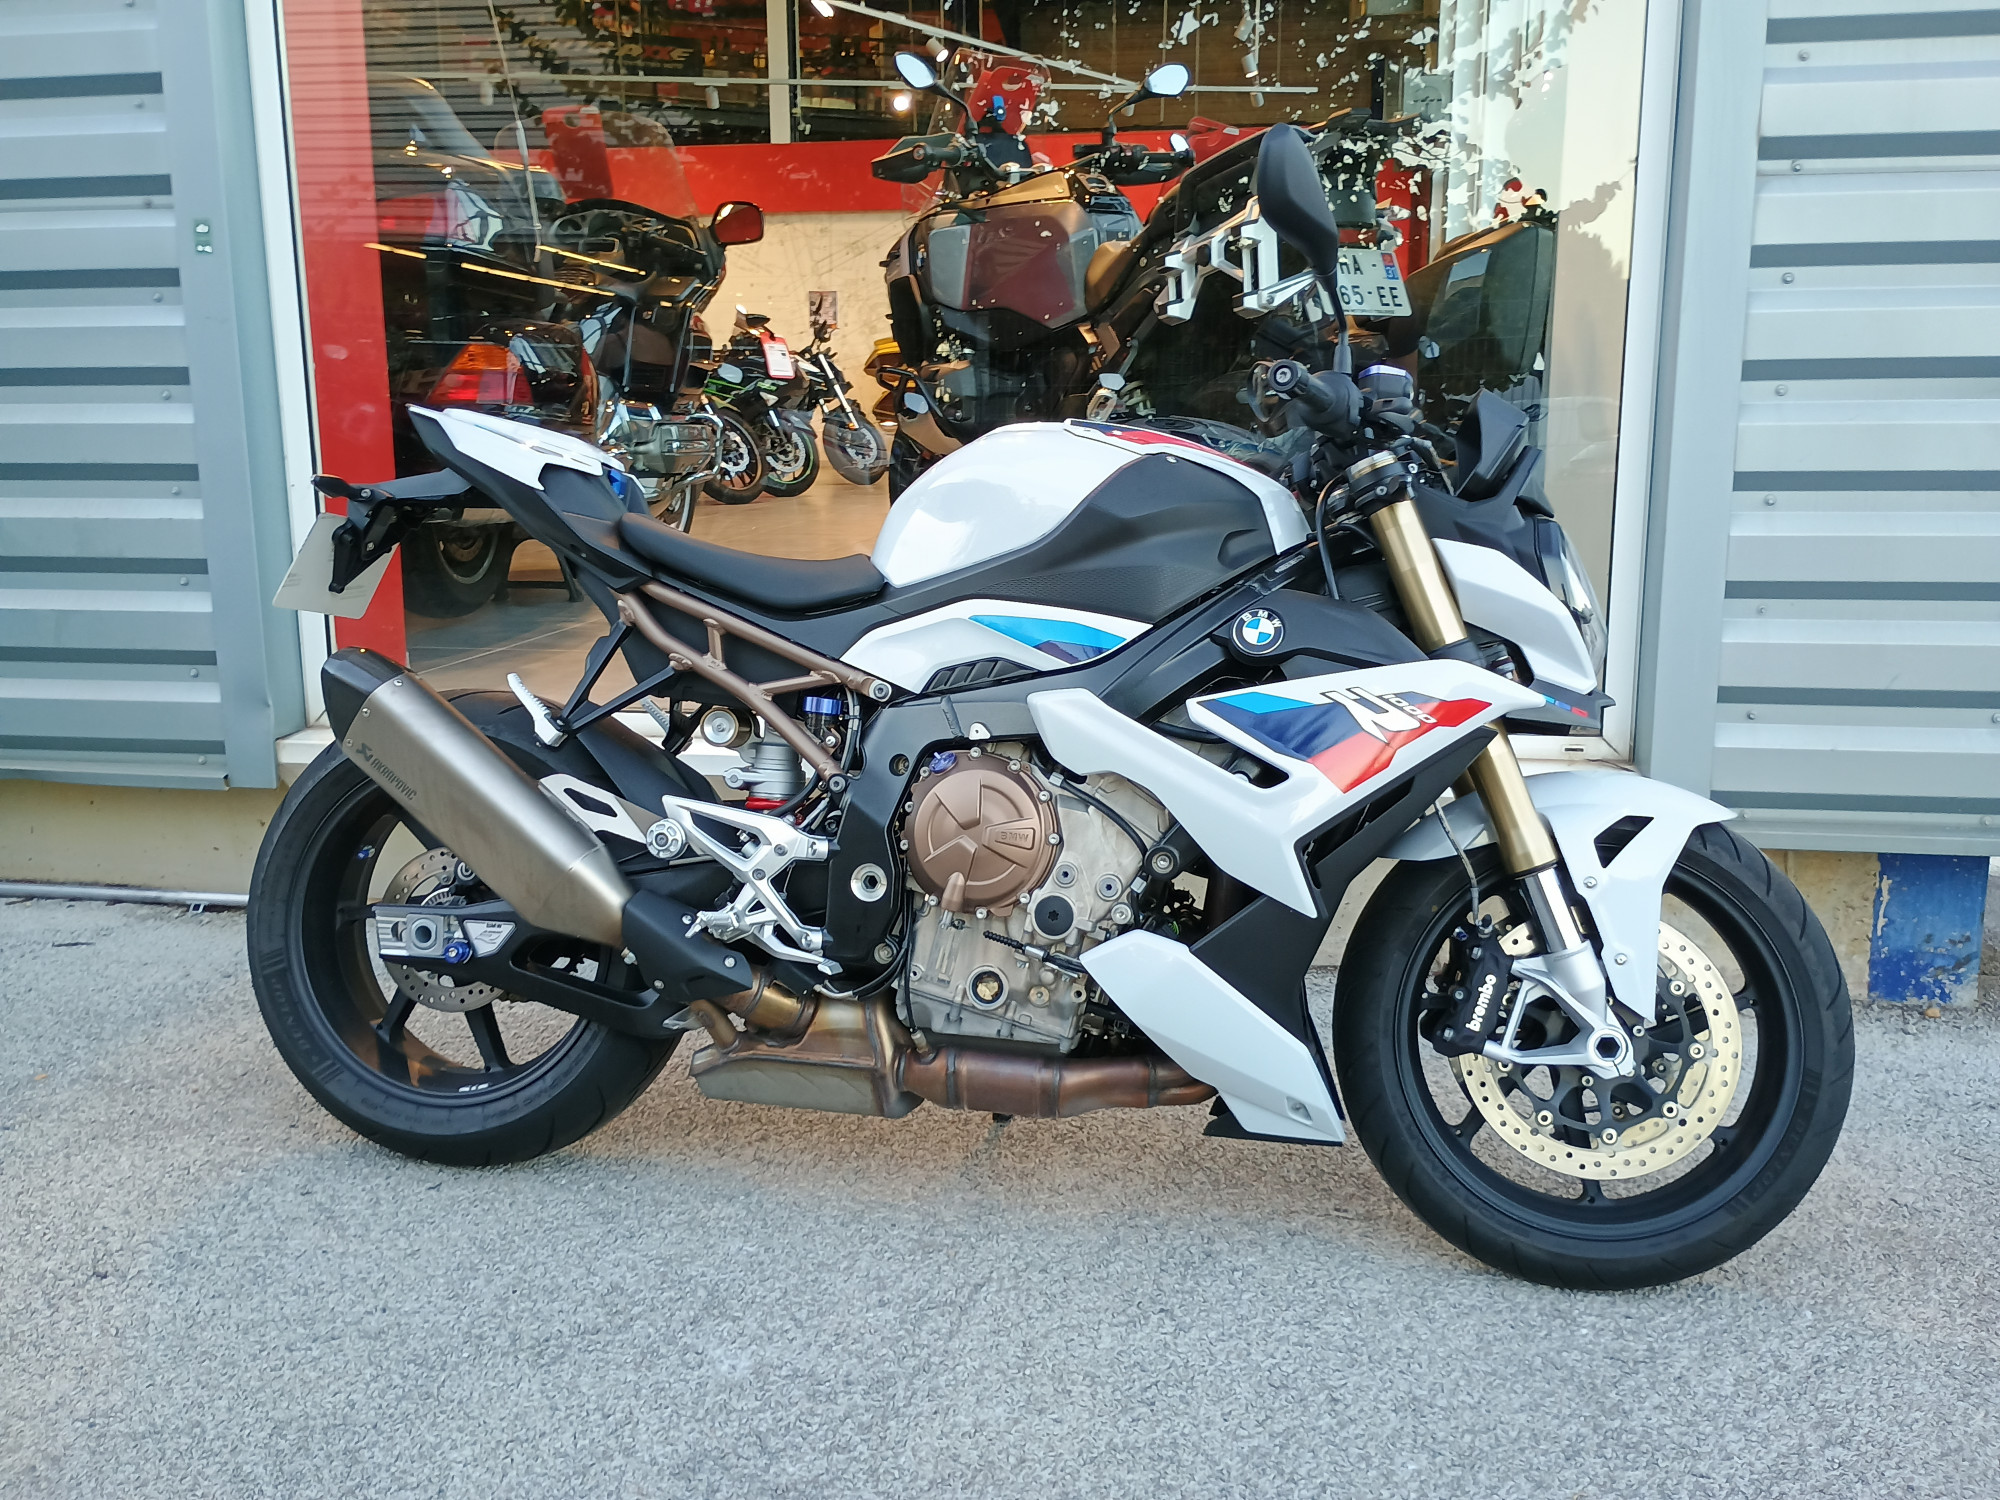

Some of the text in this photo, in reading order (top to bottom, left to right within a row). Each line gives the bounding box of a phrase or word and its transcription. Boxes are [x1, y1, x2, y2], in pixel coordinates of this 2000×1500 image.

[1241, 610, 1283, 628] BMW
[1380, 693, 1438, 724] 1000
[1001, 831, 1029, 842] BMW
[1465, 974, 1497, 1032] brembo
